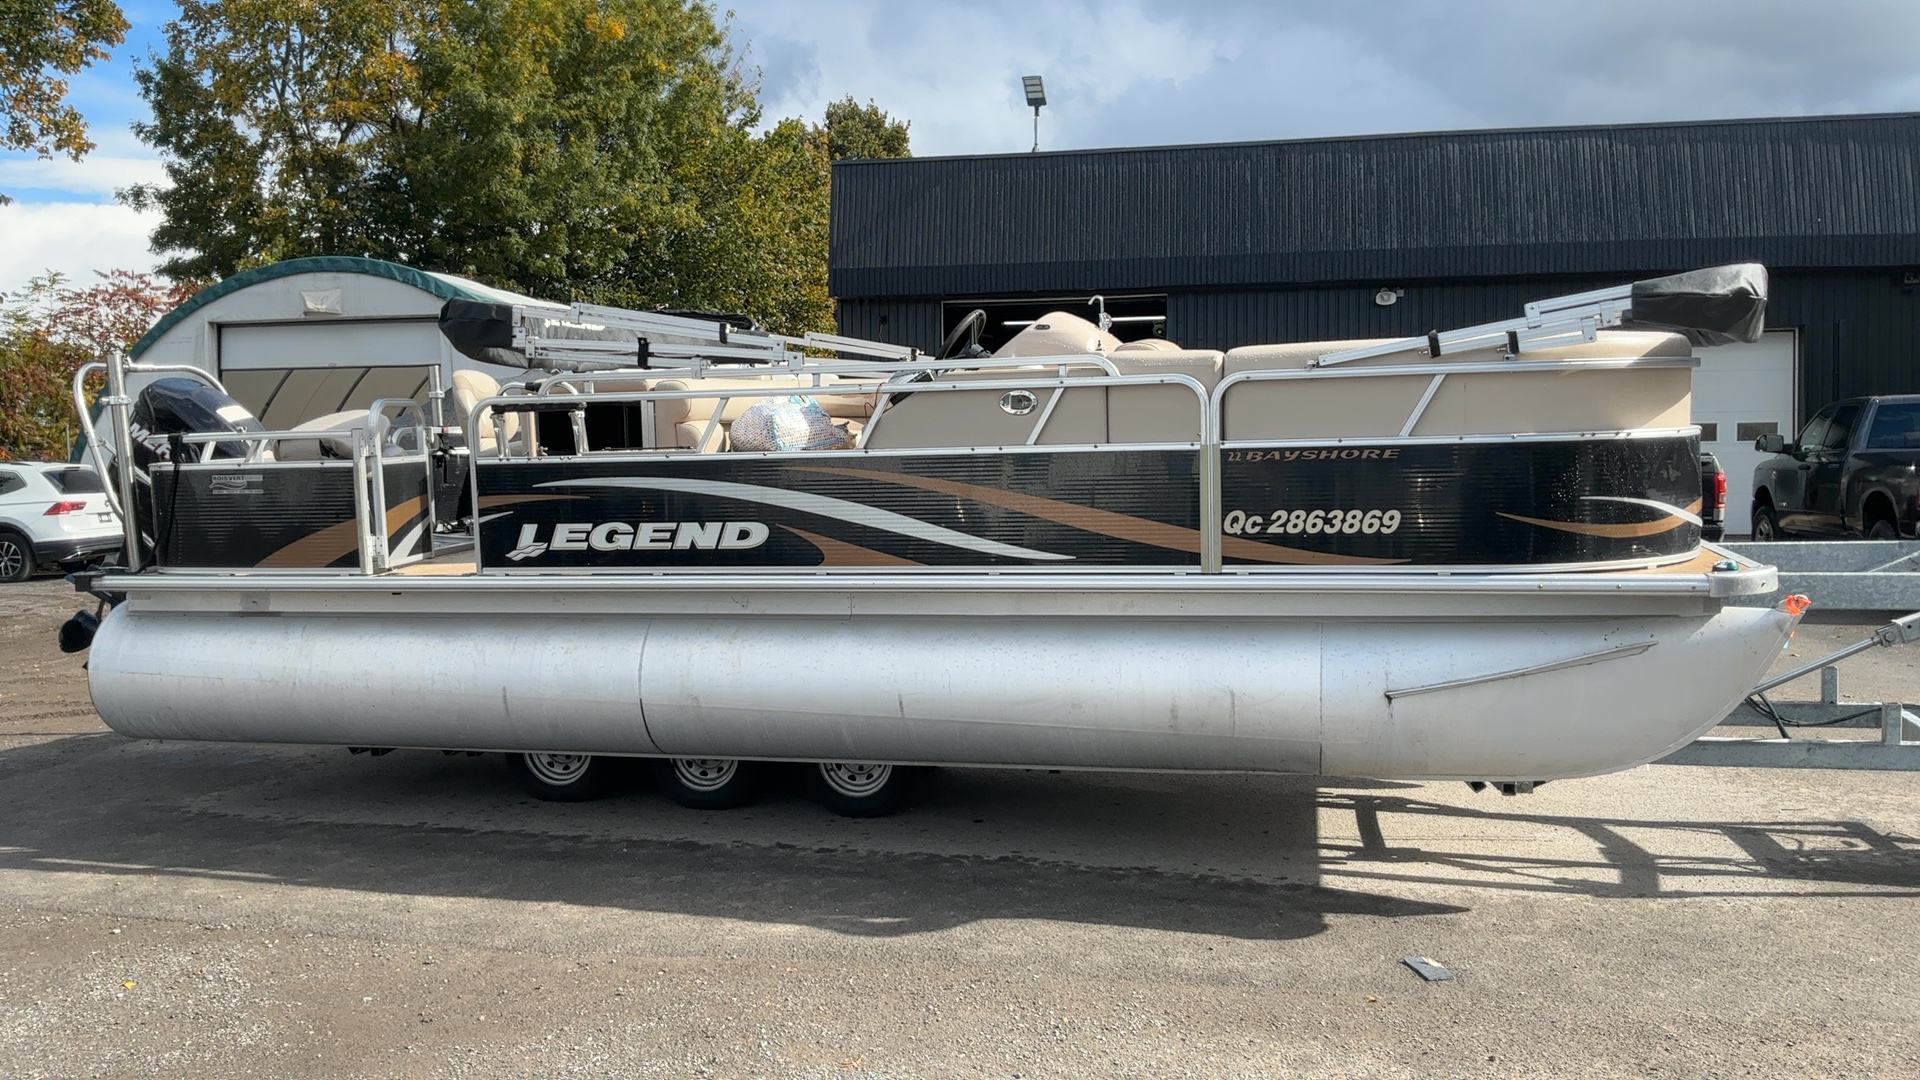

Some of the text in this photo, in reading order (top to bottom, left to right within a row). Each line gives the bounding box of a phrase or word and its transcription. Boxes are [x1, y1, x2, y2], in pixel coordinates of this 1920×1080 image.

[1245, 448, 1401, 463] BAYSHORE
[1223, 509, 1402, 536] Qc 2863869
[506, 521, 770, 561] LEGEND
